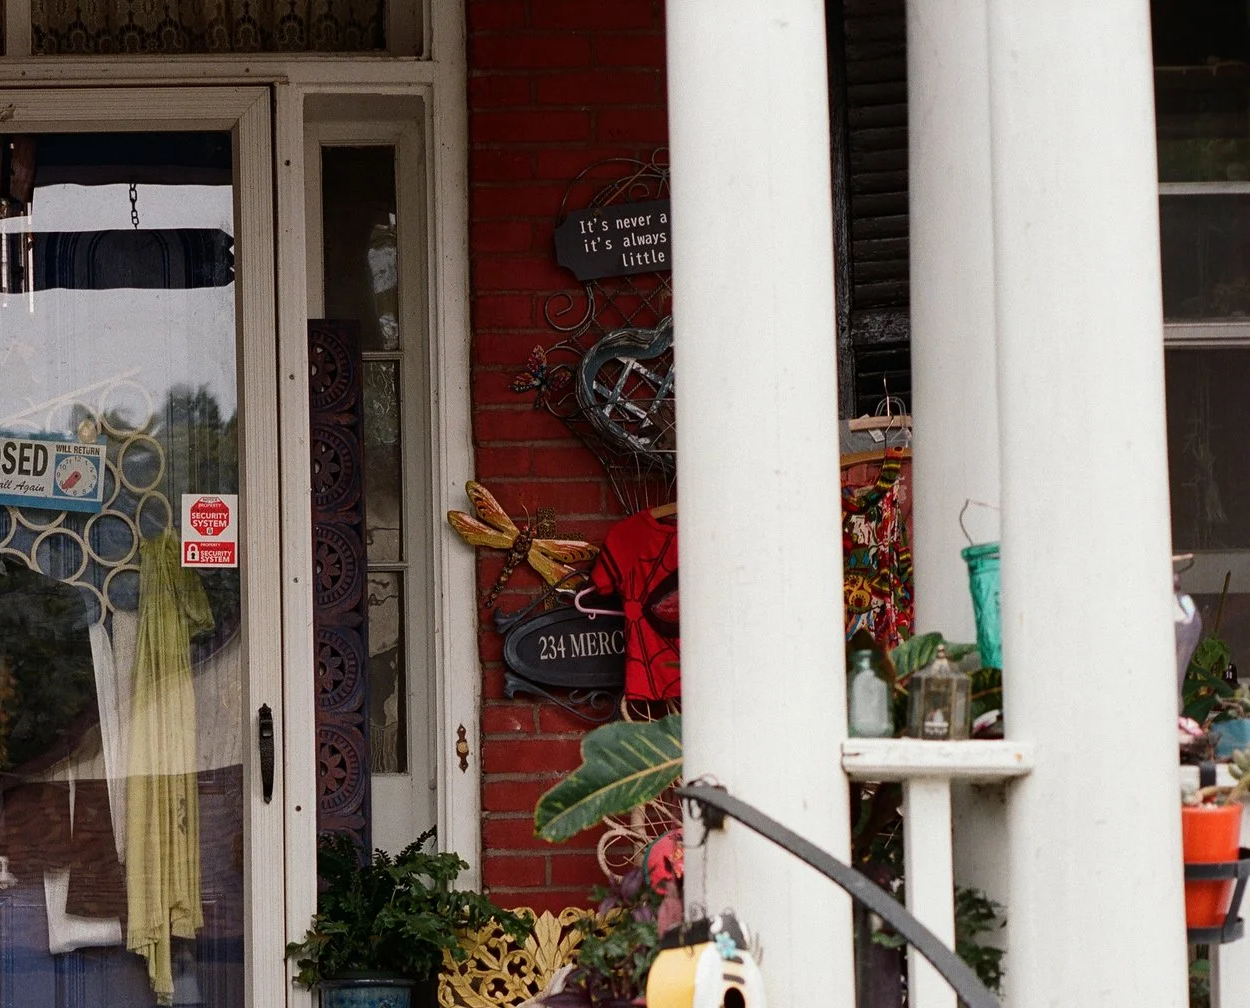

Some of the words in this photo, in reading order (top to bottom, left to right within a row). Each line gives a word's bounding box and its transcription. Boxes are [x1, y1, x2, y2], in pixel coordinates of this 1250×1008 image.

[579, 217, 609, 234] It's
[616, 214, 652, 230] never
[659, 213, 668, 224] a
[584, 236, 613, 253] it's
[623, 231, 667, 248] always
[622, 249, 665, 267] little
[55, 444, 72, 454] WILL
[73, 445, 101, 456] RETURN
[13, 480, 45, 494] Again
[538, 634, 566, 660] 234
[569, 629, 625, 658] MERC
